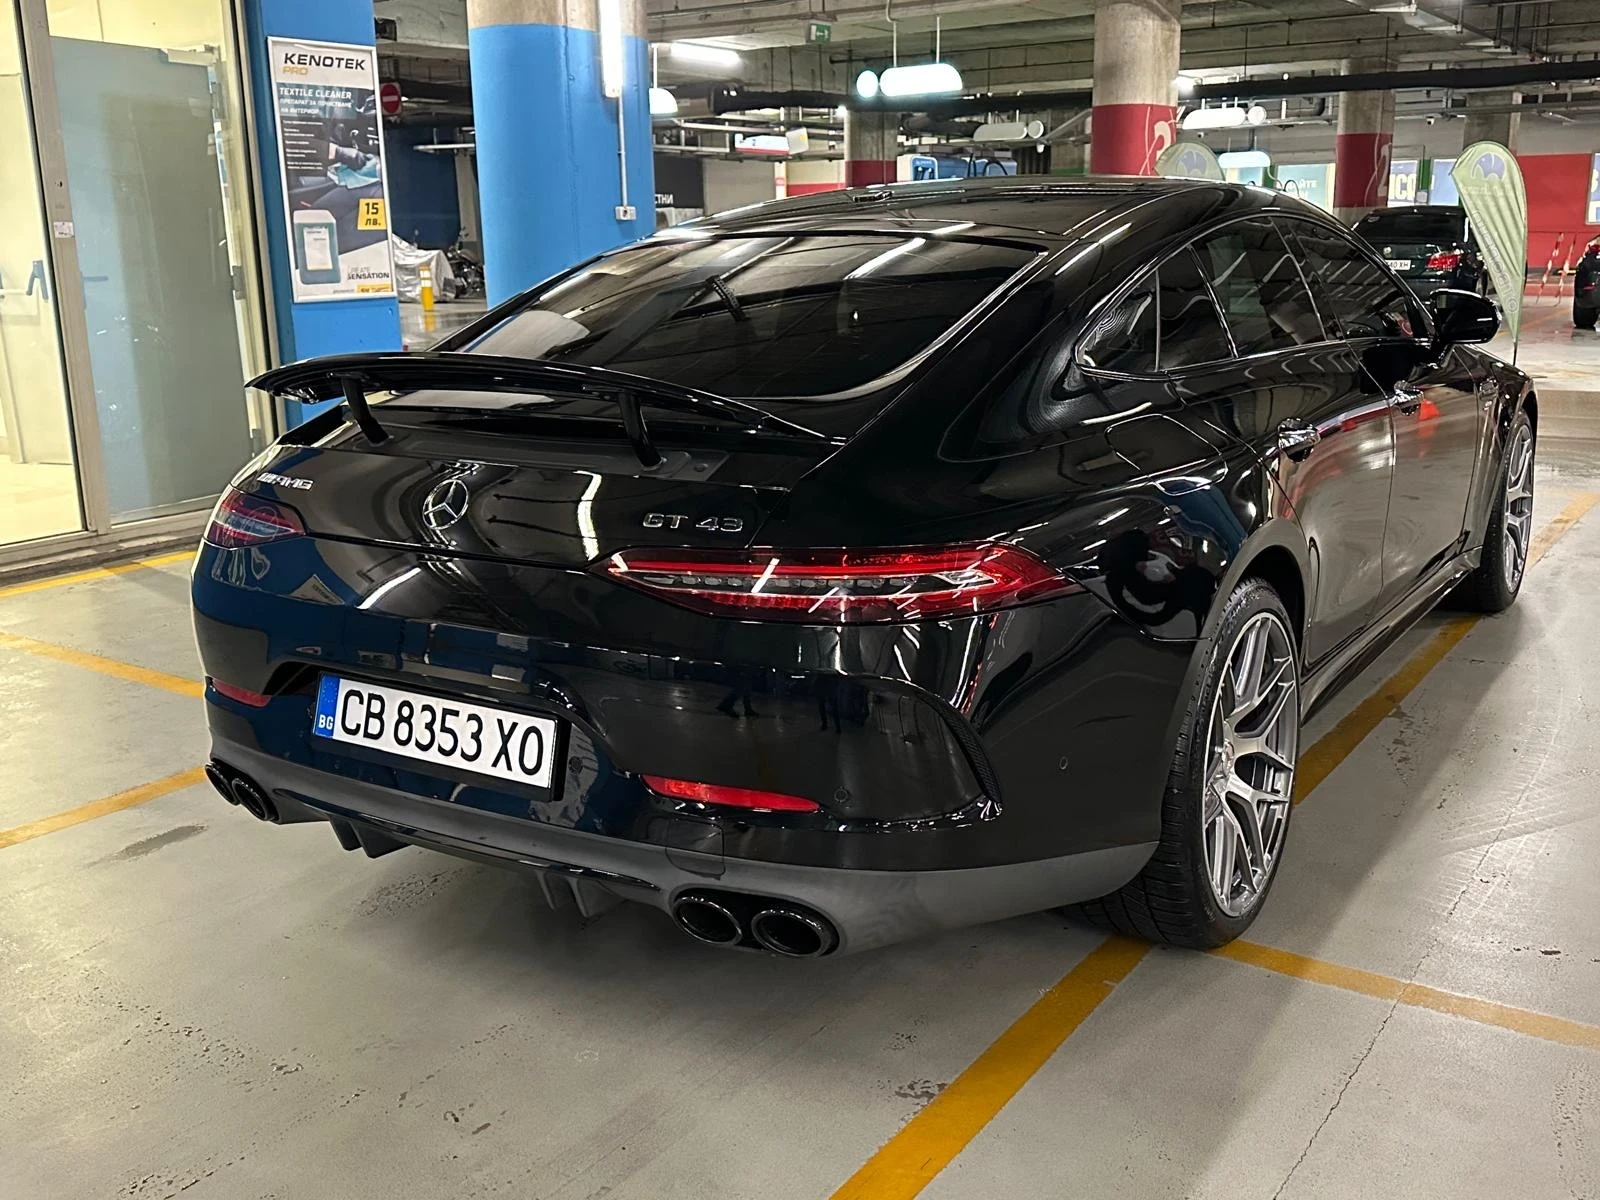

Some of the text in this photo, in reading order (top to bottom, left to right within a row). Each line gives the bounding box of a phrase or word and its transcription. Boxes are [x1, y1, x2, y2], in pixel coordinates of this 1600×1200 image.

[283, 65, 308, 75] PRO
[284, 53, 366, 71] KENOTEK
[280, 87, 352, 99] TEXTILE CLEANER
[365, 202, 379, 215] 15
[347, 272, 390, 280] SENSATION
[271, 473, 314, 490] AMG
[643, 513, 743, 531] GT 43
[318, 714, 334, 730] BG
[341, 689, 544, 776] CB 8353 XO
